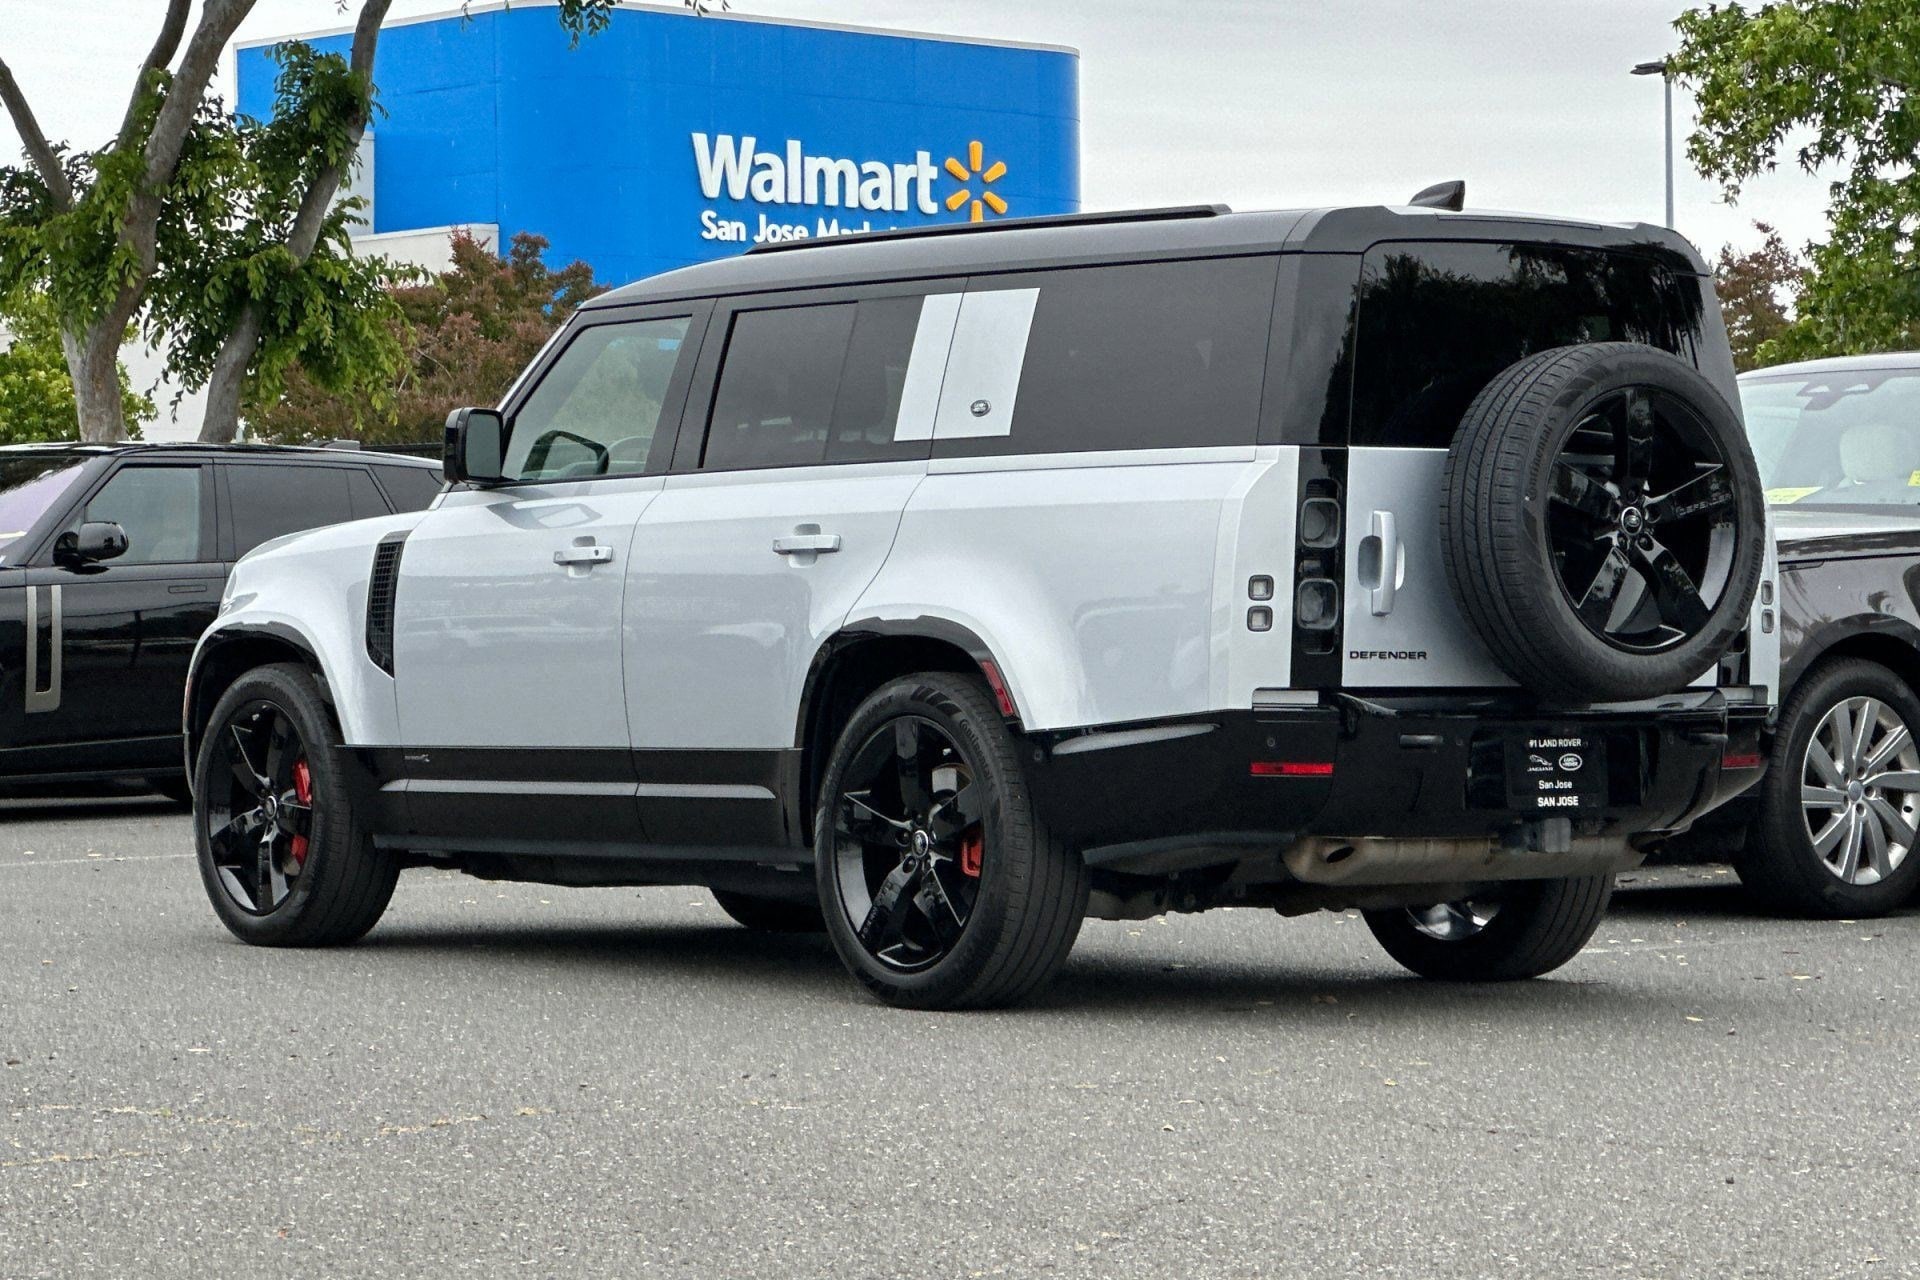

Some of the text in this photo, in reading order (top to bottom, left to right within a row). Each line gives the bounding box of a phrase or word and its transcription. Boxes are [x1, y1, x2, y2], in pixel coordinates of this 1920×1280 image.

[691, 132, 938, 214] Walmart
[701, 210, 746, 241] San
[753, 213, 809, 243] Jose
[1349, 650, 1428, 660] DEFENDER
[1538, 739, 1557, 748] LAND
[1558, 738, 1582, 747] ROVER
[1538, 780, 1573, 789] San Jose
[1537, 796, 1579, 807] SAN JOSE
